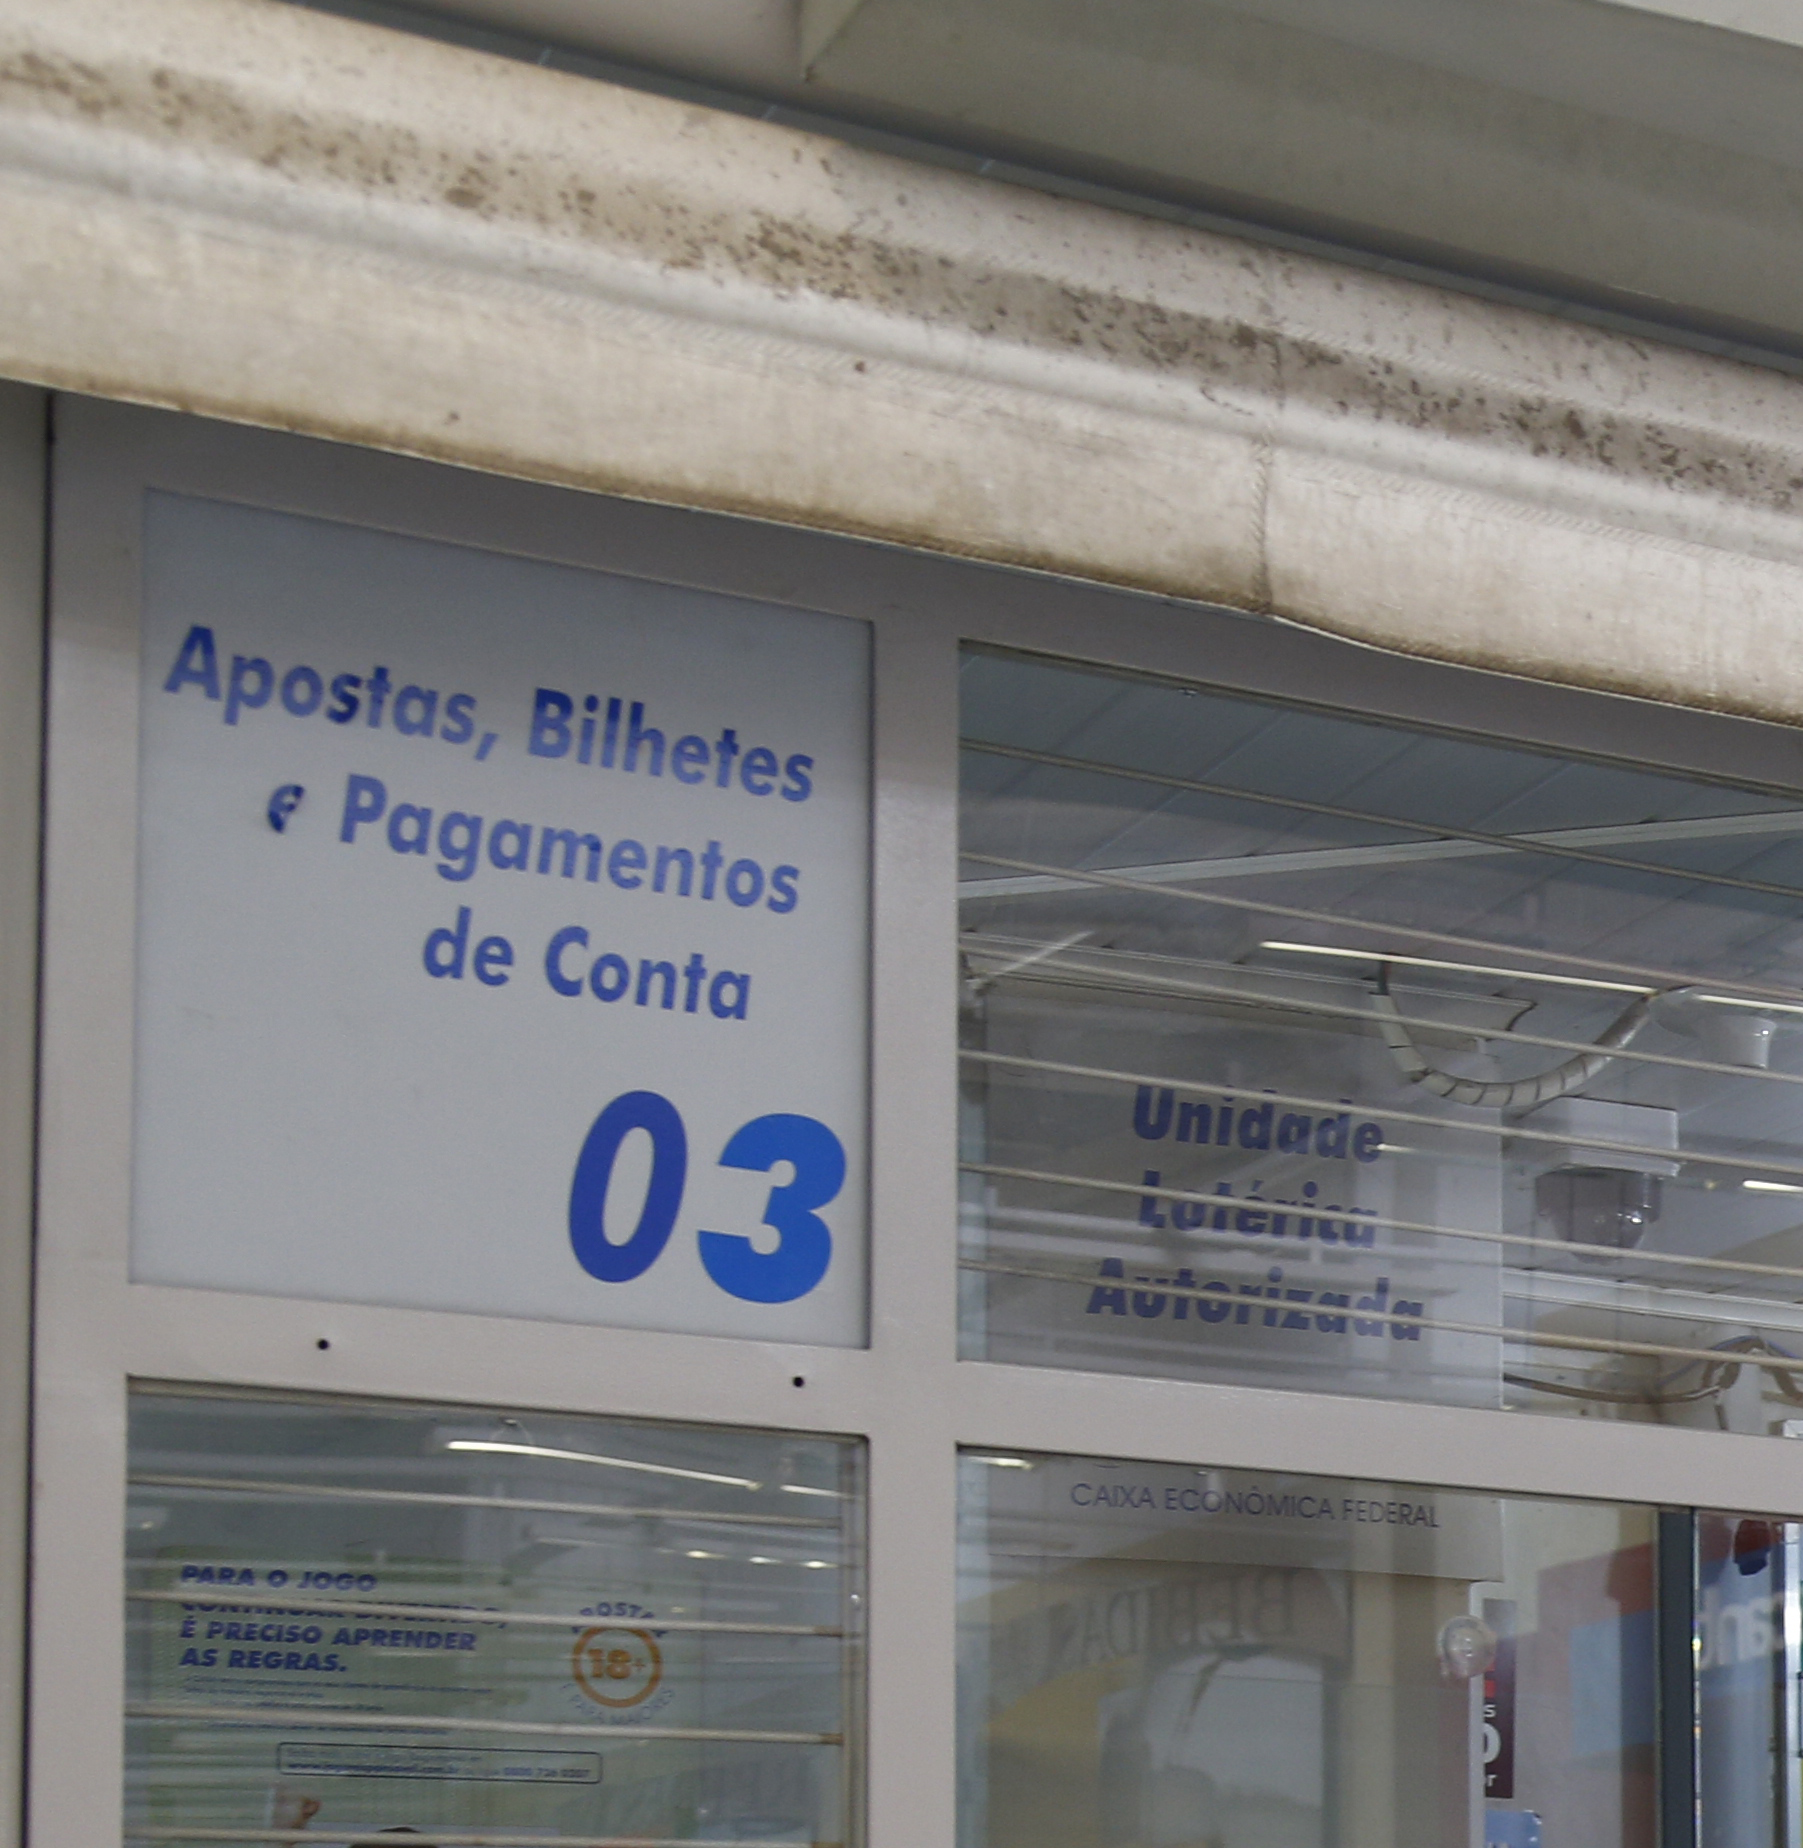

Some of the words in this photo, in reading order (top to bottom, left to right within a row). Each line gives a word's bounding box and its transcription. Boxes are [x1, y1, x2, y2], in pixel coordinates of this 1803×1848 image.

[163, 625, 498, 762] Apostas,
[527, 687, 814, 802] Bilhetes
[339, 773, 800, 914] Pagamentos
[422, 906, 515, 987] de
[544, 926, 751, 1020] Conta
[1131, 1082, 1385, 1164] Unidade
[568, 1089, 847, 1303] 03
[1086, 1258, 1424, 1342] Autorizada
[1070, 1482, 1156, 1510] CAIXA
[1165, 1486, 1336, 1521] ECONÔMICA
[1341, 1499, 1439, 1528] FEDERAL
[181, 1565, 254, 1585] PARA
[267, 1570, 288, 1587] O
[298, 1572, 377, 1592] JOGO
[180, 1648, 218, 1667] AS
[229, 1650, 347, 1672] REGRAS.
[181, 1616, 197, 1638] É
[206, 1621, 323, 1644] PRECISO
[332, 1627, 477, 1650] APRENDER
